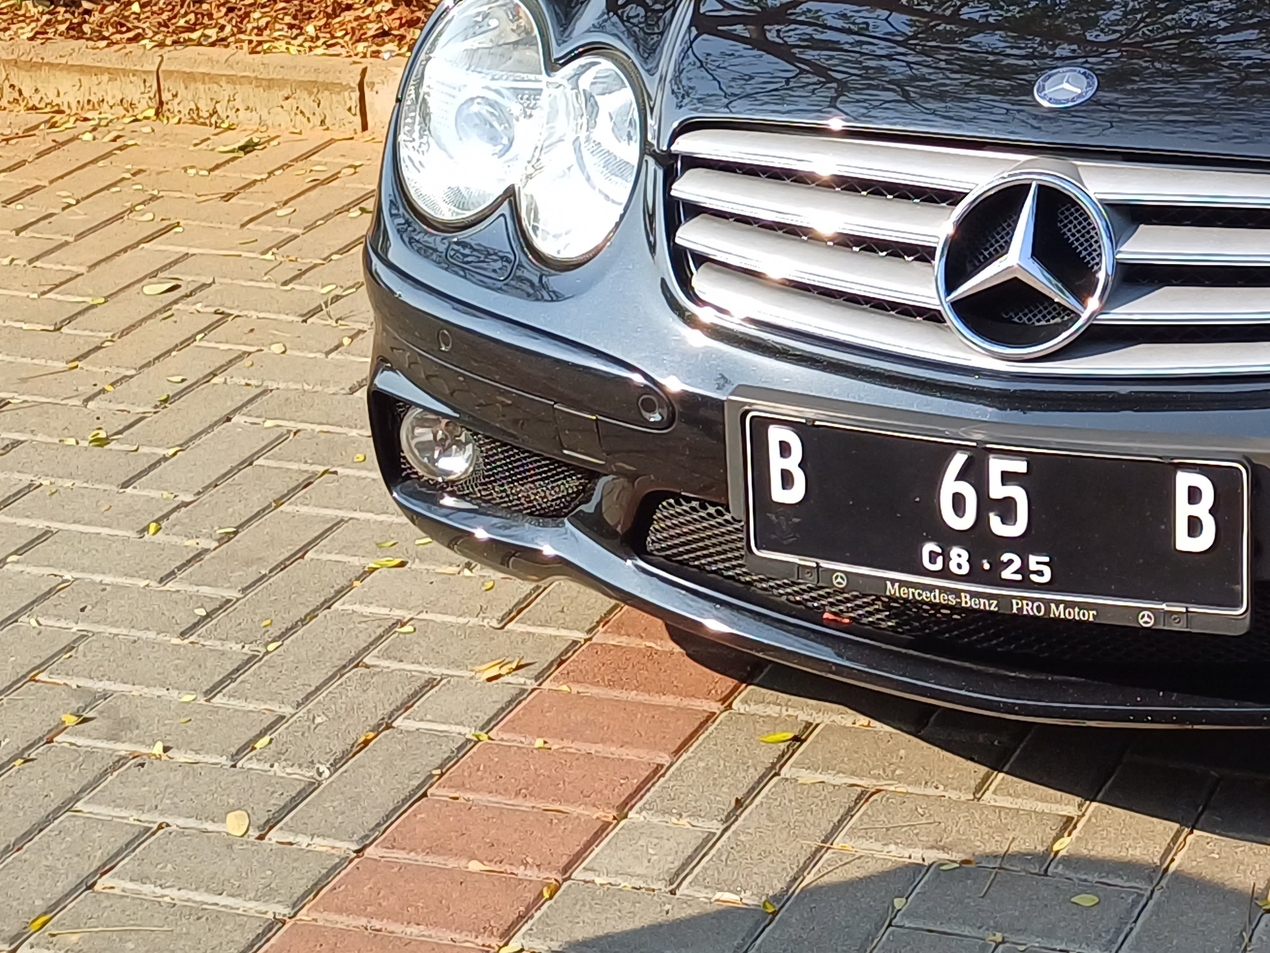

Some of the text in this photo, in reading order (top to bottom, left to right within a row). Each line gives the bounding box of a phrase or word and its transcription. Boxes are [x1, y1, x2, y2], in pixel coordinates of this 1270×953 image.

[767, 423, 1218, 553] B 65 B
[885, 580, 1098, 623] Mercedes-Benz PRO Motor
